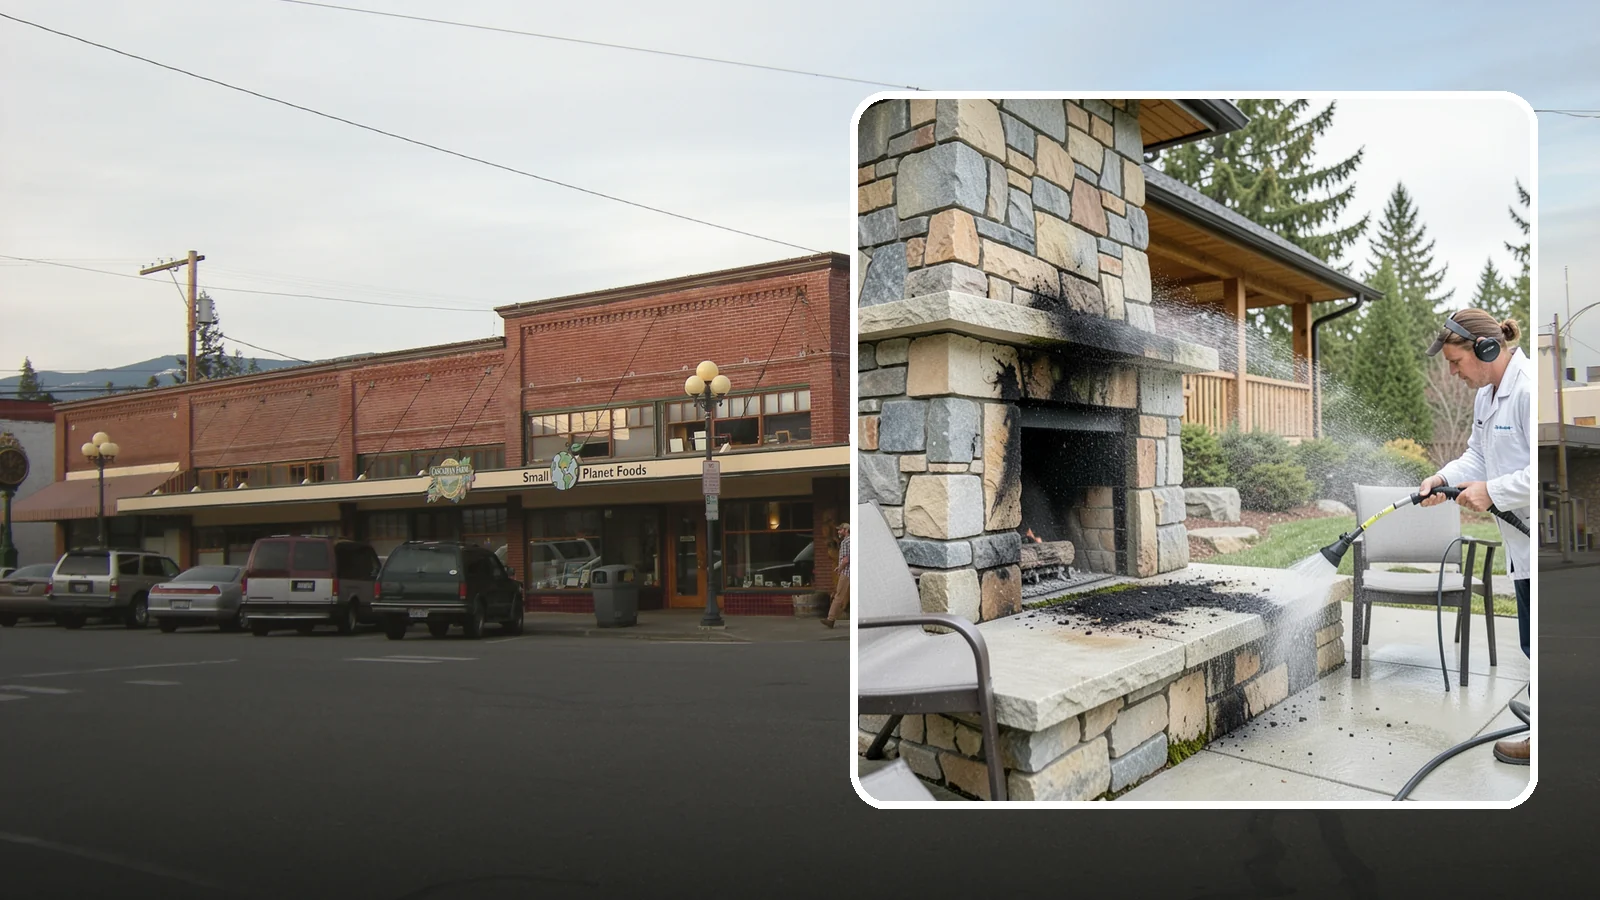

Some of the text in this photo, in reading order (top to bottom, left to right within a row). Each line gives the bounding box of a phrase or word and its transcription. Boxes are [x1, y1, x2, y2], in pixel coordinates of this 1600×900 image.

[523, 464, 647, 482] Small Planet Foods
